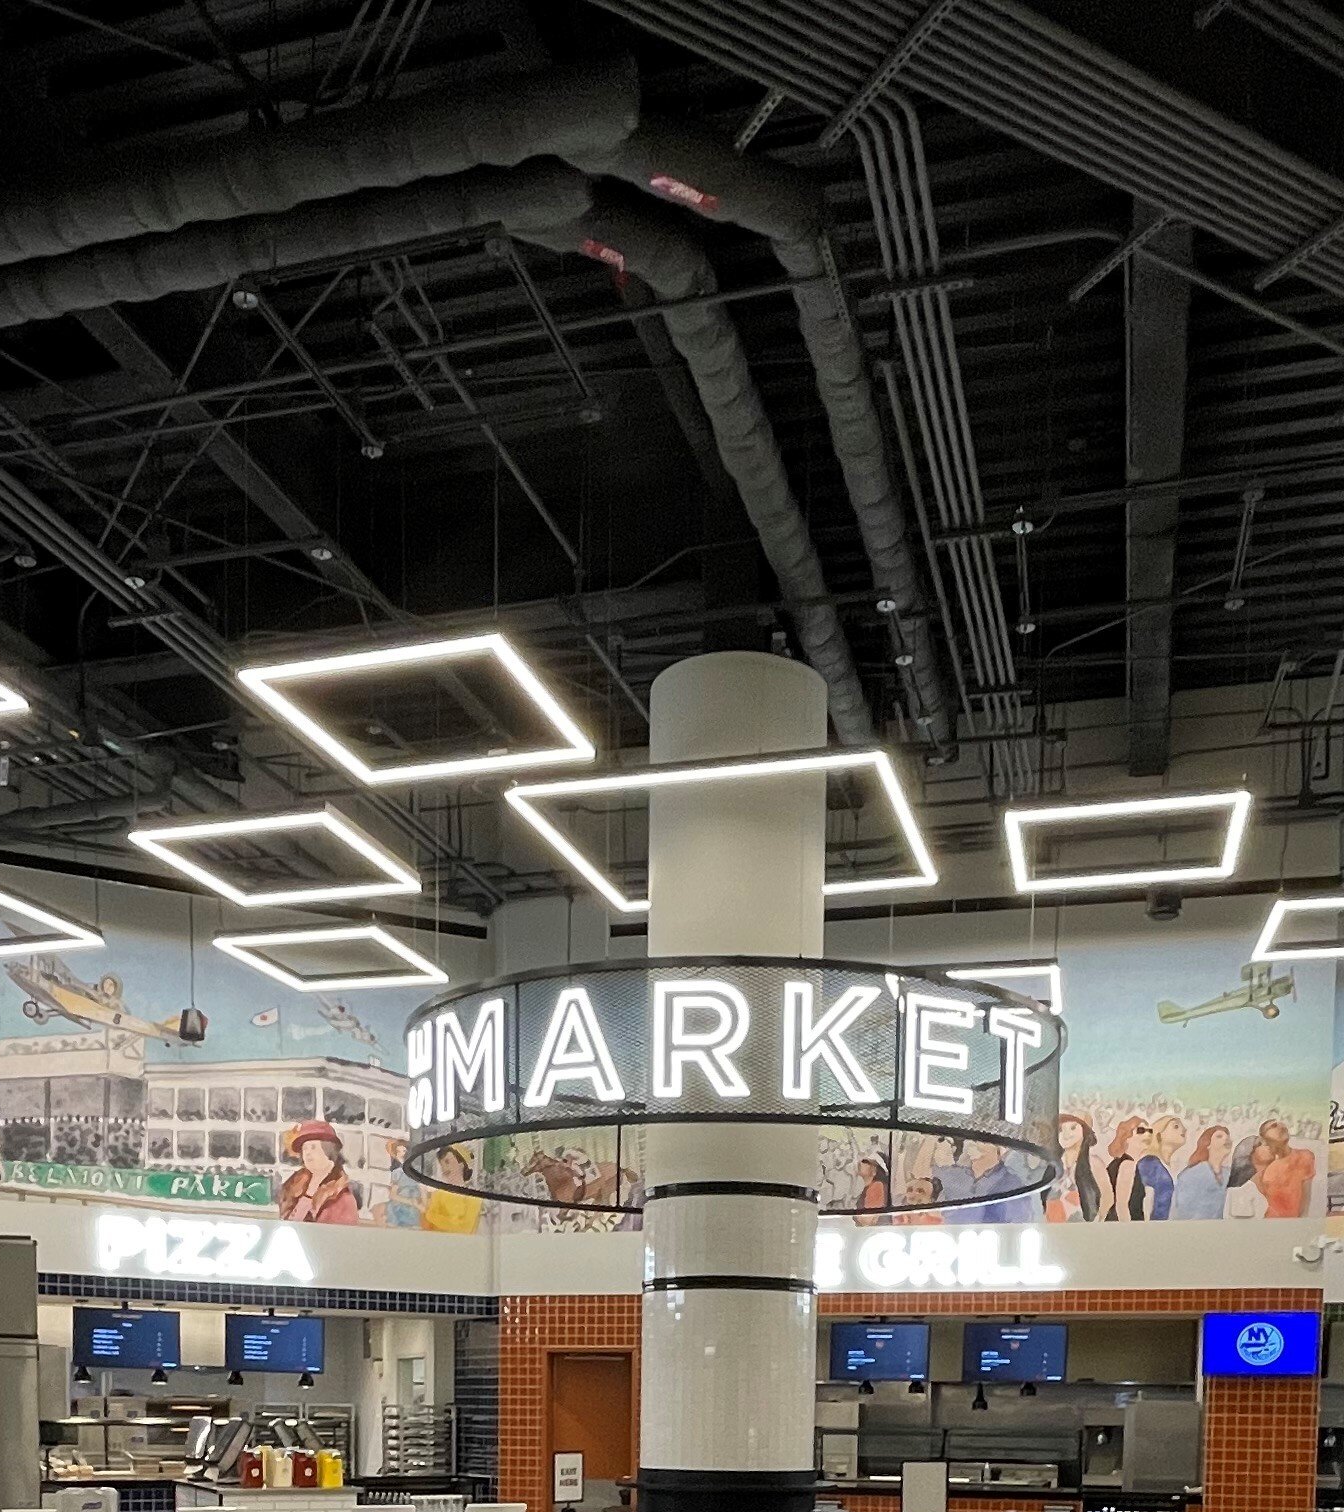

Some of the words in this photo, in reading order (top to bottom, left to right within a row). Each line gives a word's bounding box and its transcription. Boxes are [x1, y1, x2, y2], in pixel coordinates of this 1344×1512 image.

[435, 980, 1043, 1124] MARKET
[171, 1174, 262, 1200] PARK
[98, 1214, 315, 1281] PIZZA
[858, 1228, 1067, 1287] GRILL
